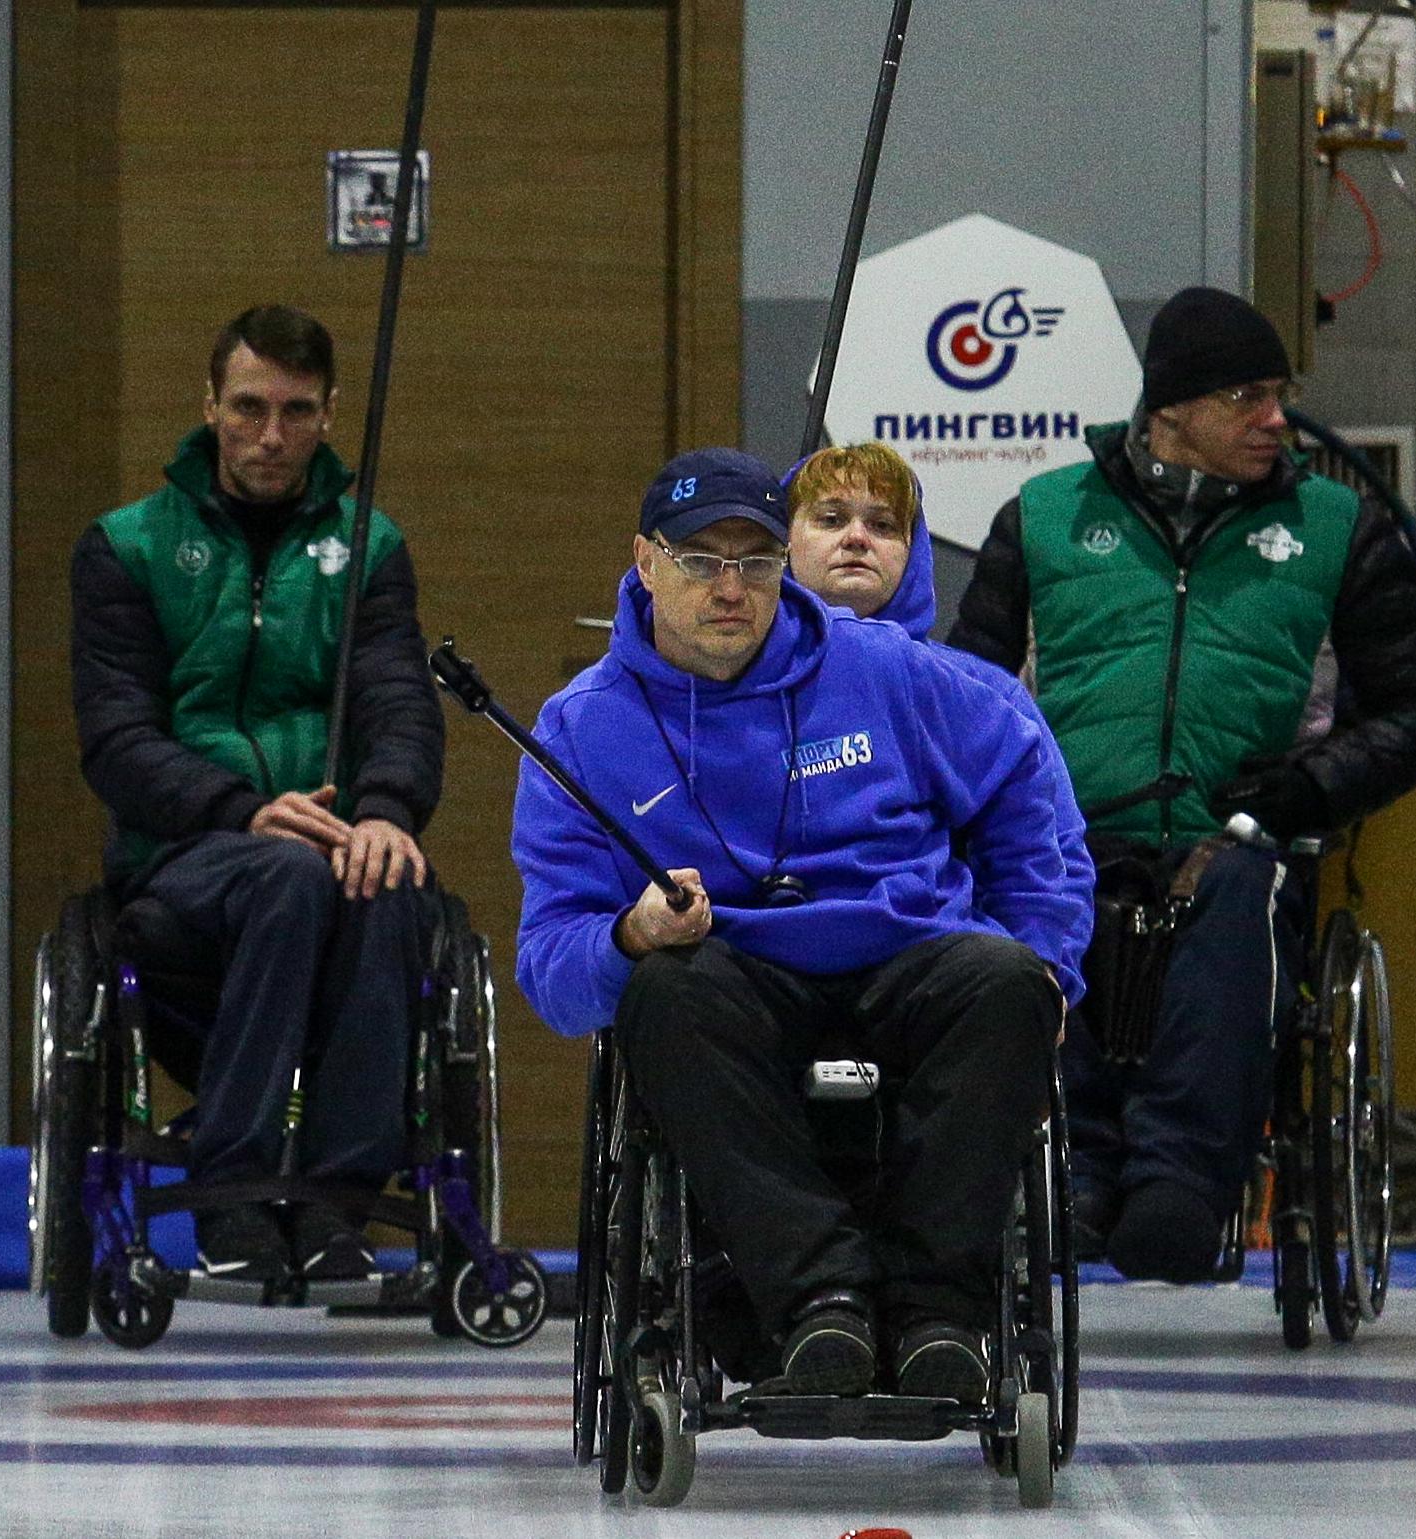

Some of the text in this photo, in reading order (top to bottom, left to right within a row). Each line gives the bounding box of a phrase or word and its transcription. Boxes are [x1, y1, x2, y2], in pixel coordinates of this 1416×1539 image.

[874, 412, 1079, 440] ПИНГВИН
[671, 478, 696, 502] 63
[842, 733, 872, 767] 63
